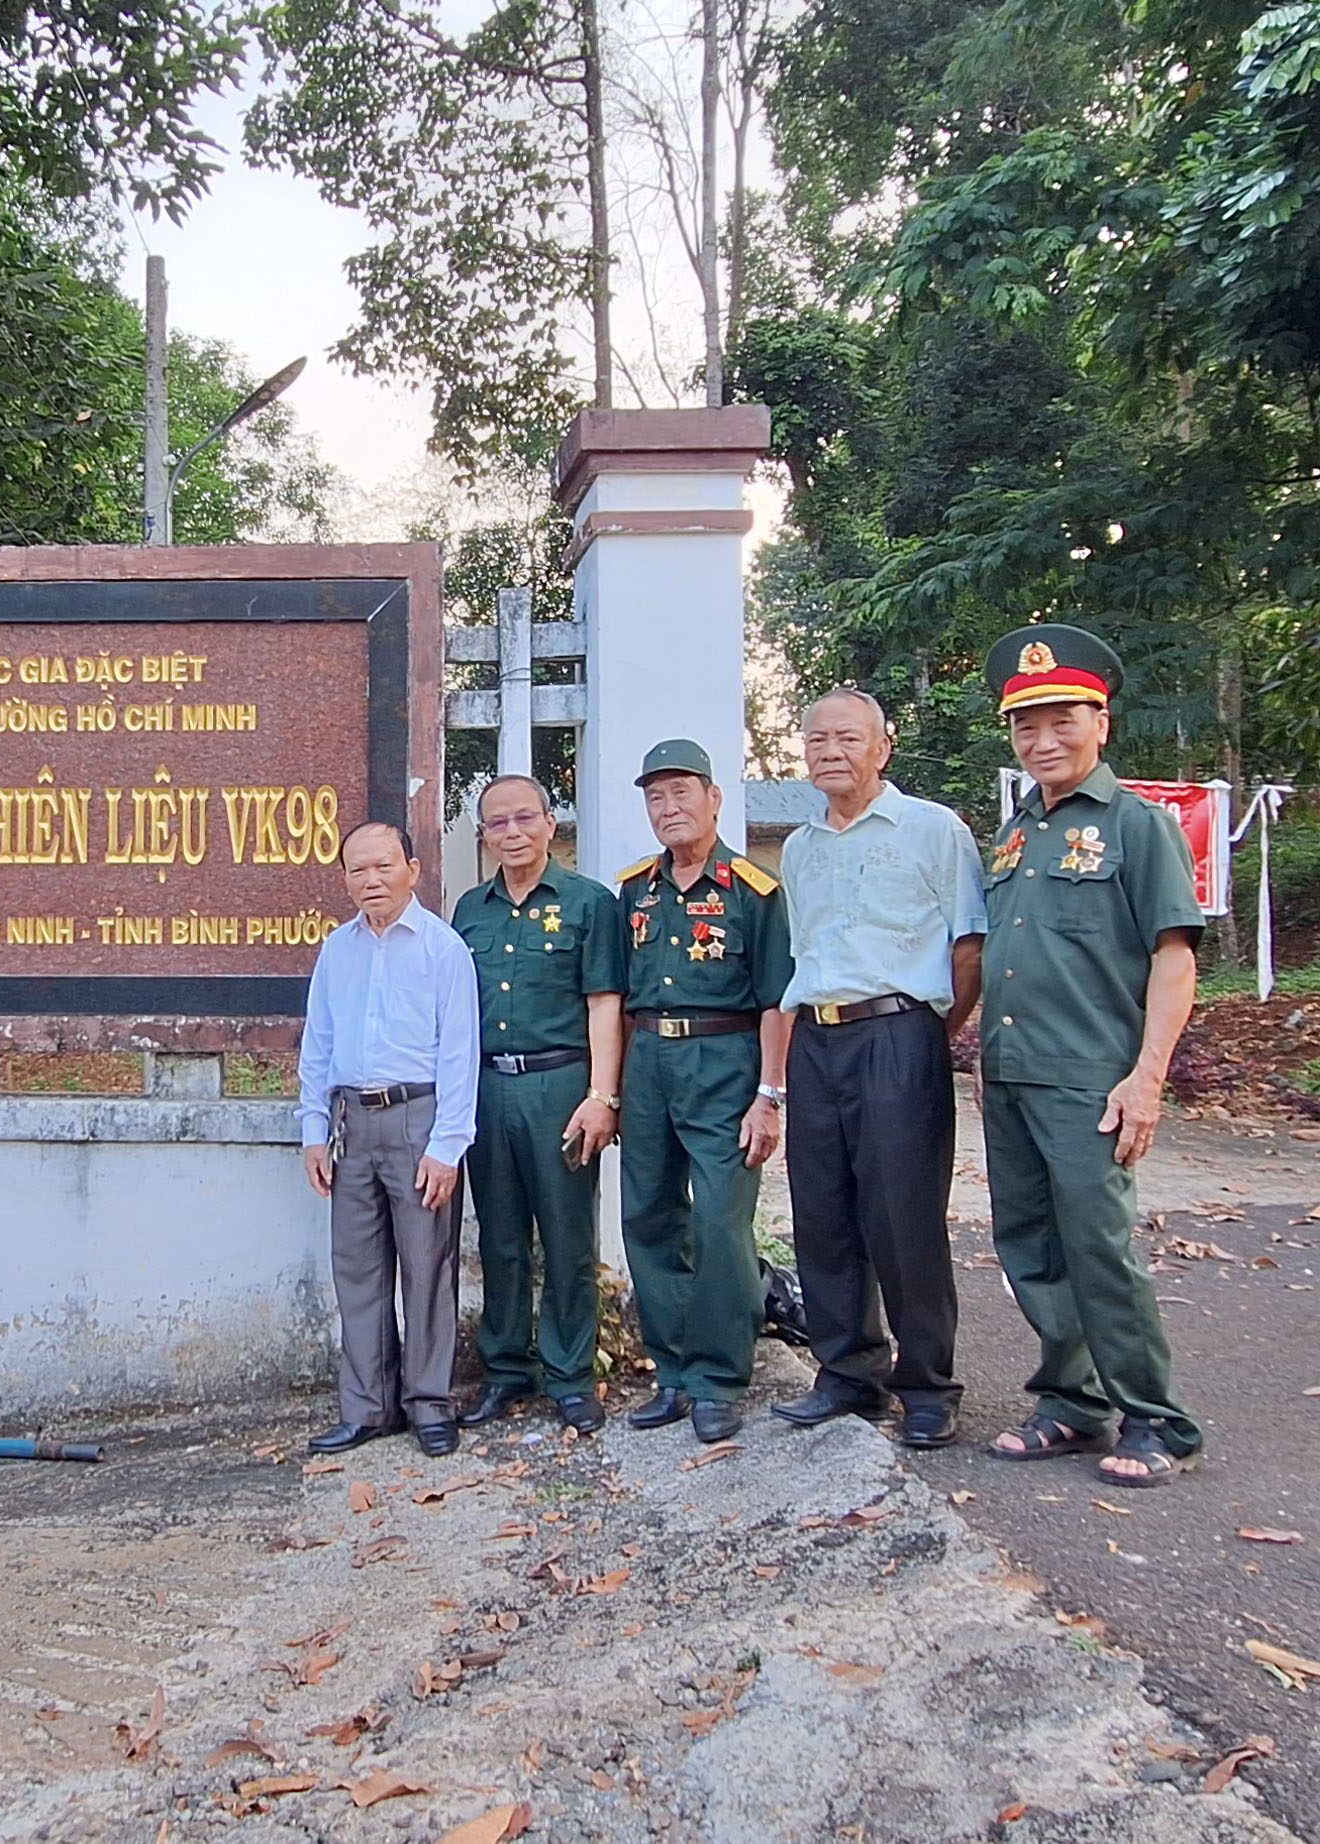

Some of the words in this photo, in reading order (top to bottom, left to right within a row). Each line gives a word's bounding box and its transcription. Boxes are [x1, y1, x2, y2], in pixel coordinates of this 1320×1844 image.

[20, 657, 69, 684] GIA
[75, 650, 133, 690] ĐẶC
[141, 650, 208, 690] BIỆT
[76, 694, 116, 732] HỒ
[123, 697, 174, 732] CHÍ
[182, 704, 257, 732] MINH
[104, 763, 210, 885] LIỆU
[221, 784, 341, 866] VK98
[7, 916, 75, 945] NINH
[97, 906, 162, 945] TỈNH
[171, 909, 239, 945] BÌNH
